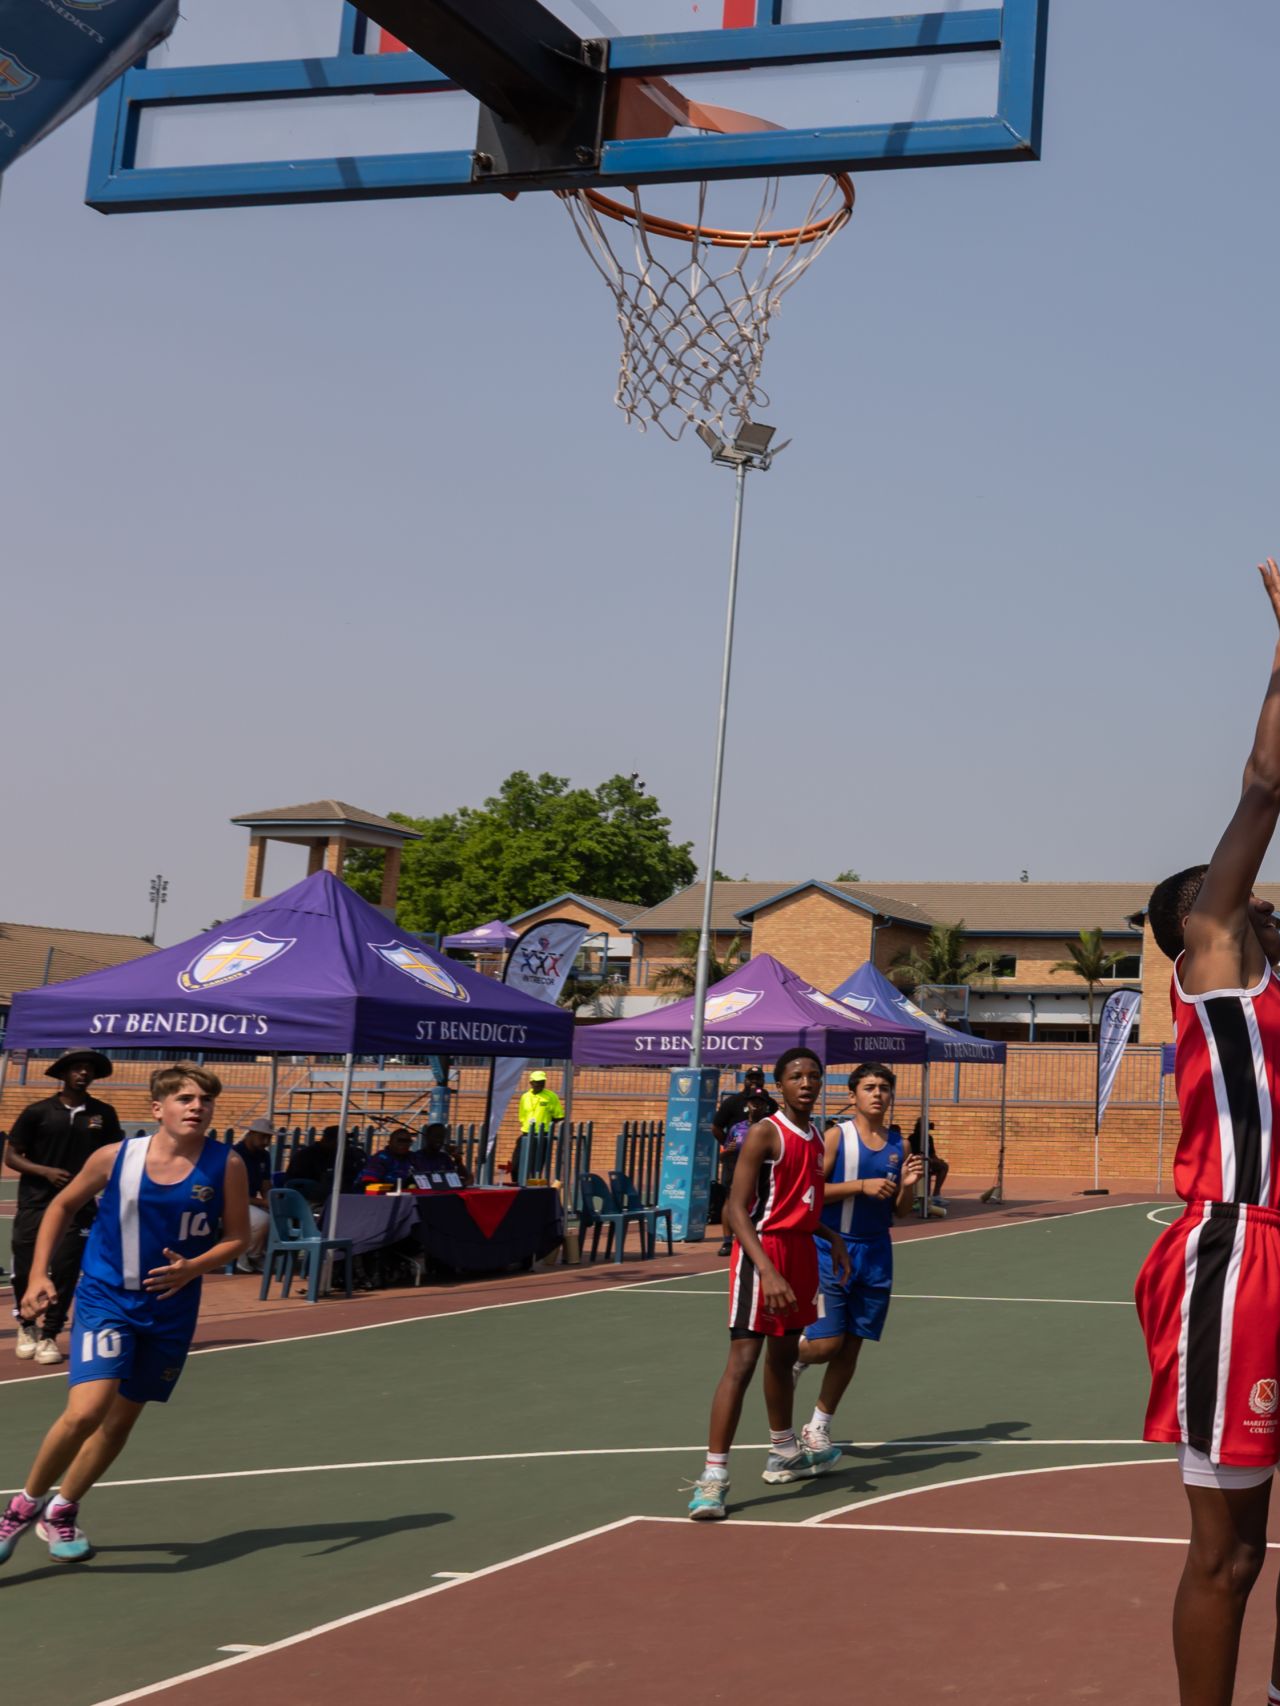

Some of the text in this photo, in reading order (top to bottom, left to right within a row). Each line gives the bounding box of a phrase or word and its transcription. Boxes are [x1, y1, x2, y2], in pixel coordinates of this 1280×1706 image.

[89, 1012, 269, 1035] ST BENEDICT'S
[415, 1020, 528, 1044] ST BENEDICT'S
[634, 1035, 764, 1051] ST BENDICT'S
[801, 1185, 815, 1212] 4
[81, 1328, 122, 1362] 10
